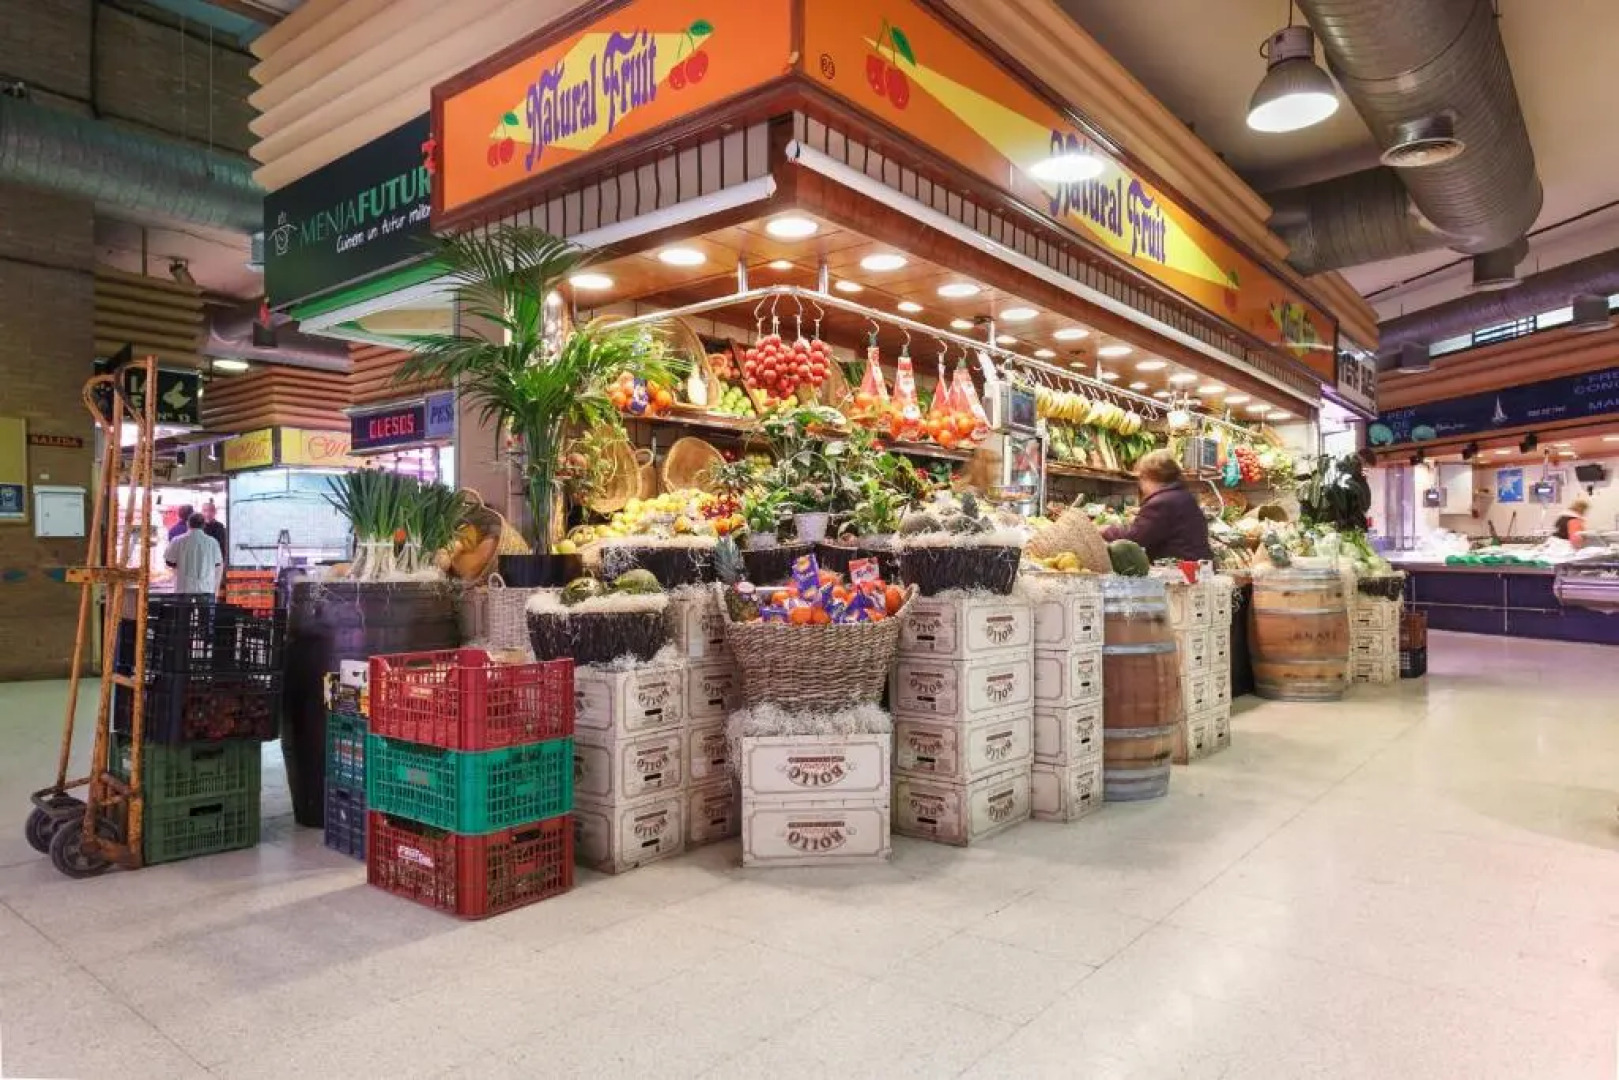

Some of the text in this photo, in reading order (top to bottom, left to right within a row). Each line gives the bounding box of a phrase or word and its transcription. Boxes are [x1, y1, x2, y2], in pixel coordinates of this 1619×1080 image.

[525, 26, 657, 171] Natural Fruit
[1050, 130, 1165, 264] Natural Fruit
[369, 413, 415, 439] QUESOS
[31, 434, 80, 447] SALIDA
[788, 764, 844, 785] BOLLO
[788, 829, 844, 850] BOLLO
